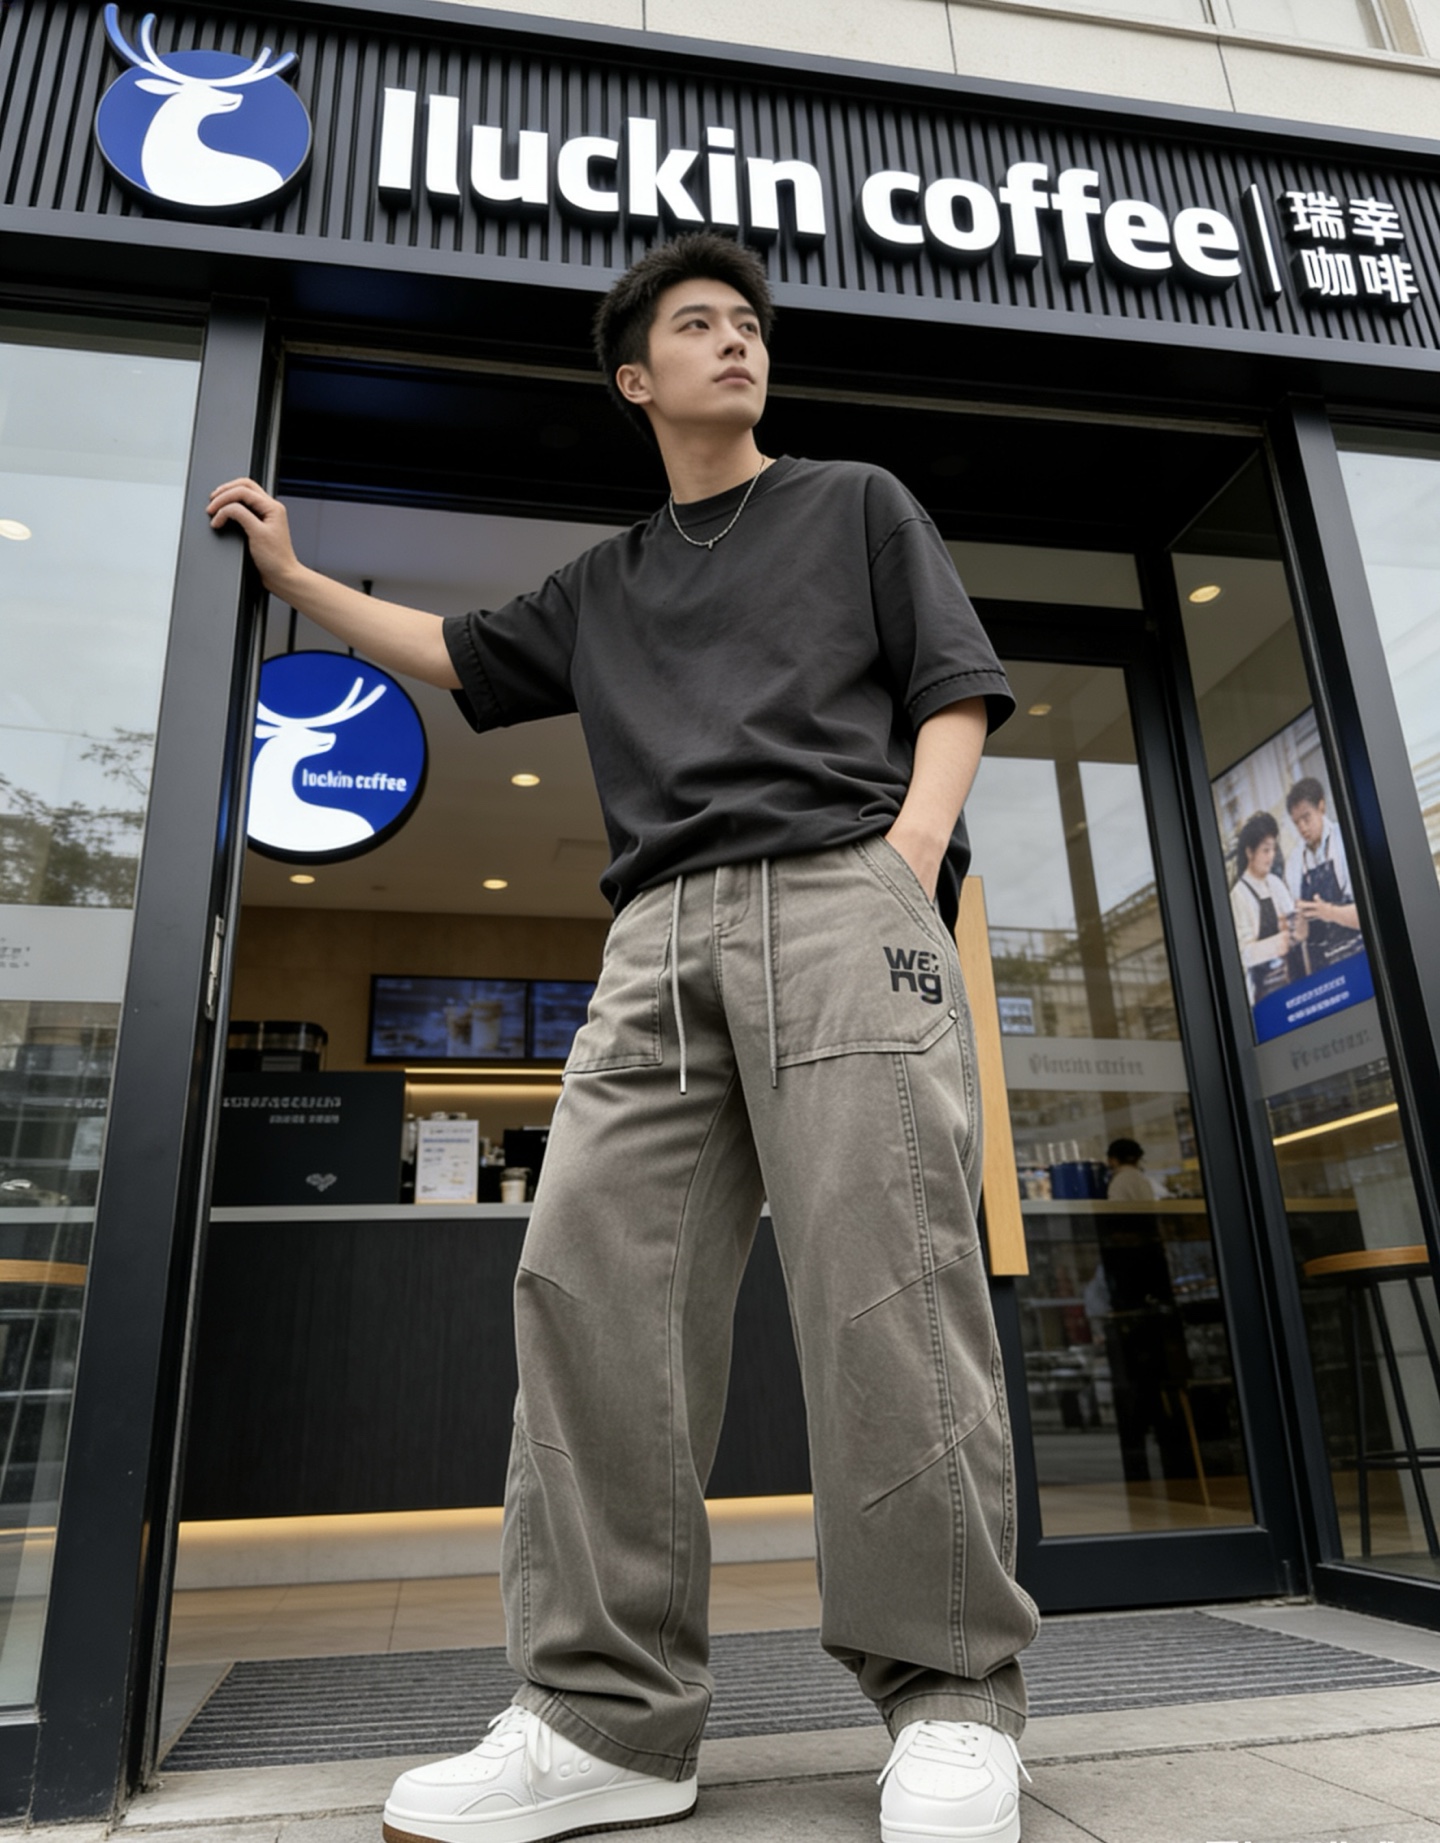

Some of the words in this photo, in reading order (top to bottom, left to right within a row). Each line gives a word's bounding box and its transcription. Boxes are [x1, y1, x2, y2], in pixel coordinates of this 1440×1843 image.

[862, 161, 1242, 278] coffee
[1286, 191, 1404, 246] 瑞幸
[1300, 246, 1419, 303] 咖啡
